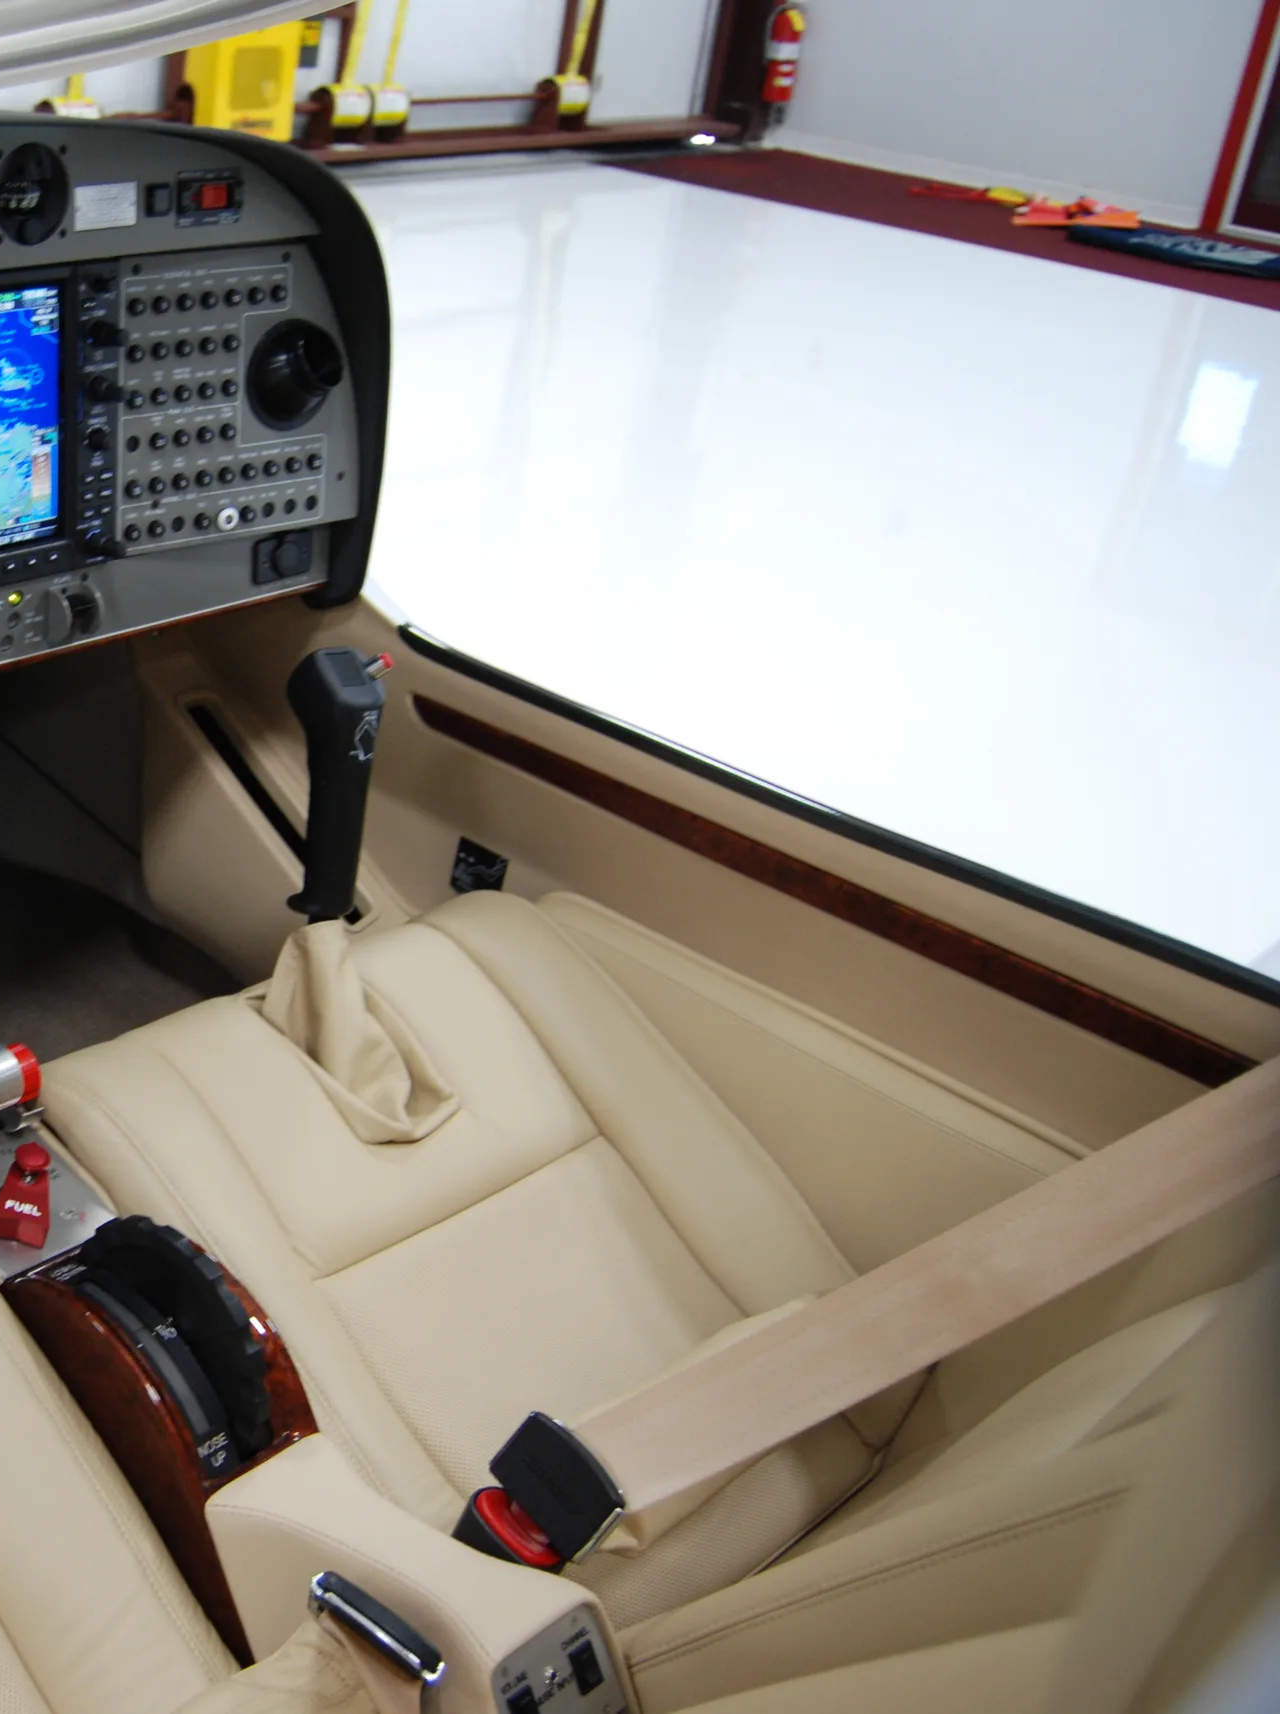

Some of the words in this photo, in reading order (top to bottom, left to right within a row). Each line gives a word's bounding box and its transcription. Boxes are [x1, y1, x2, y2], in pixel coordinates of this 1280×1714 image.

[4, 1199, 42, 1217] FUEL
[197, 1432, 229, 1458] NOSE
[210, 1450, 227, 1467] UP
